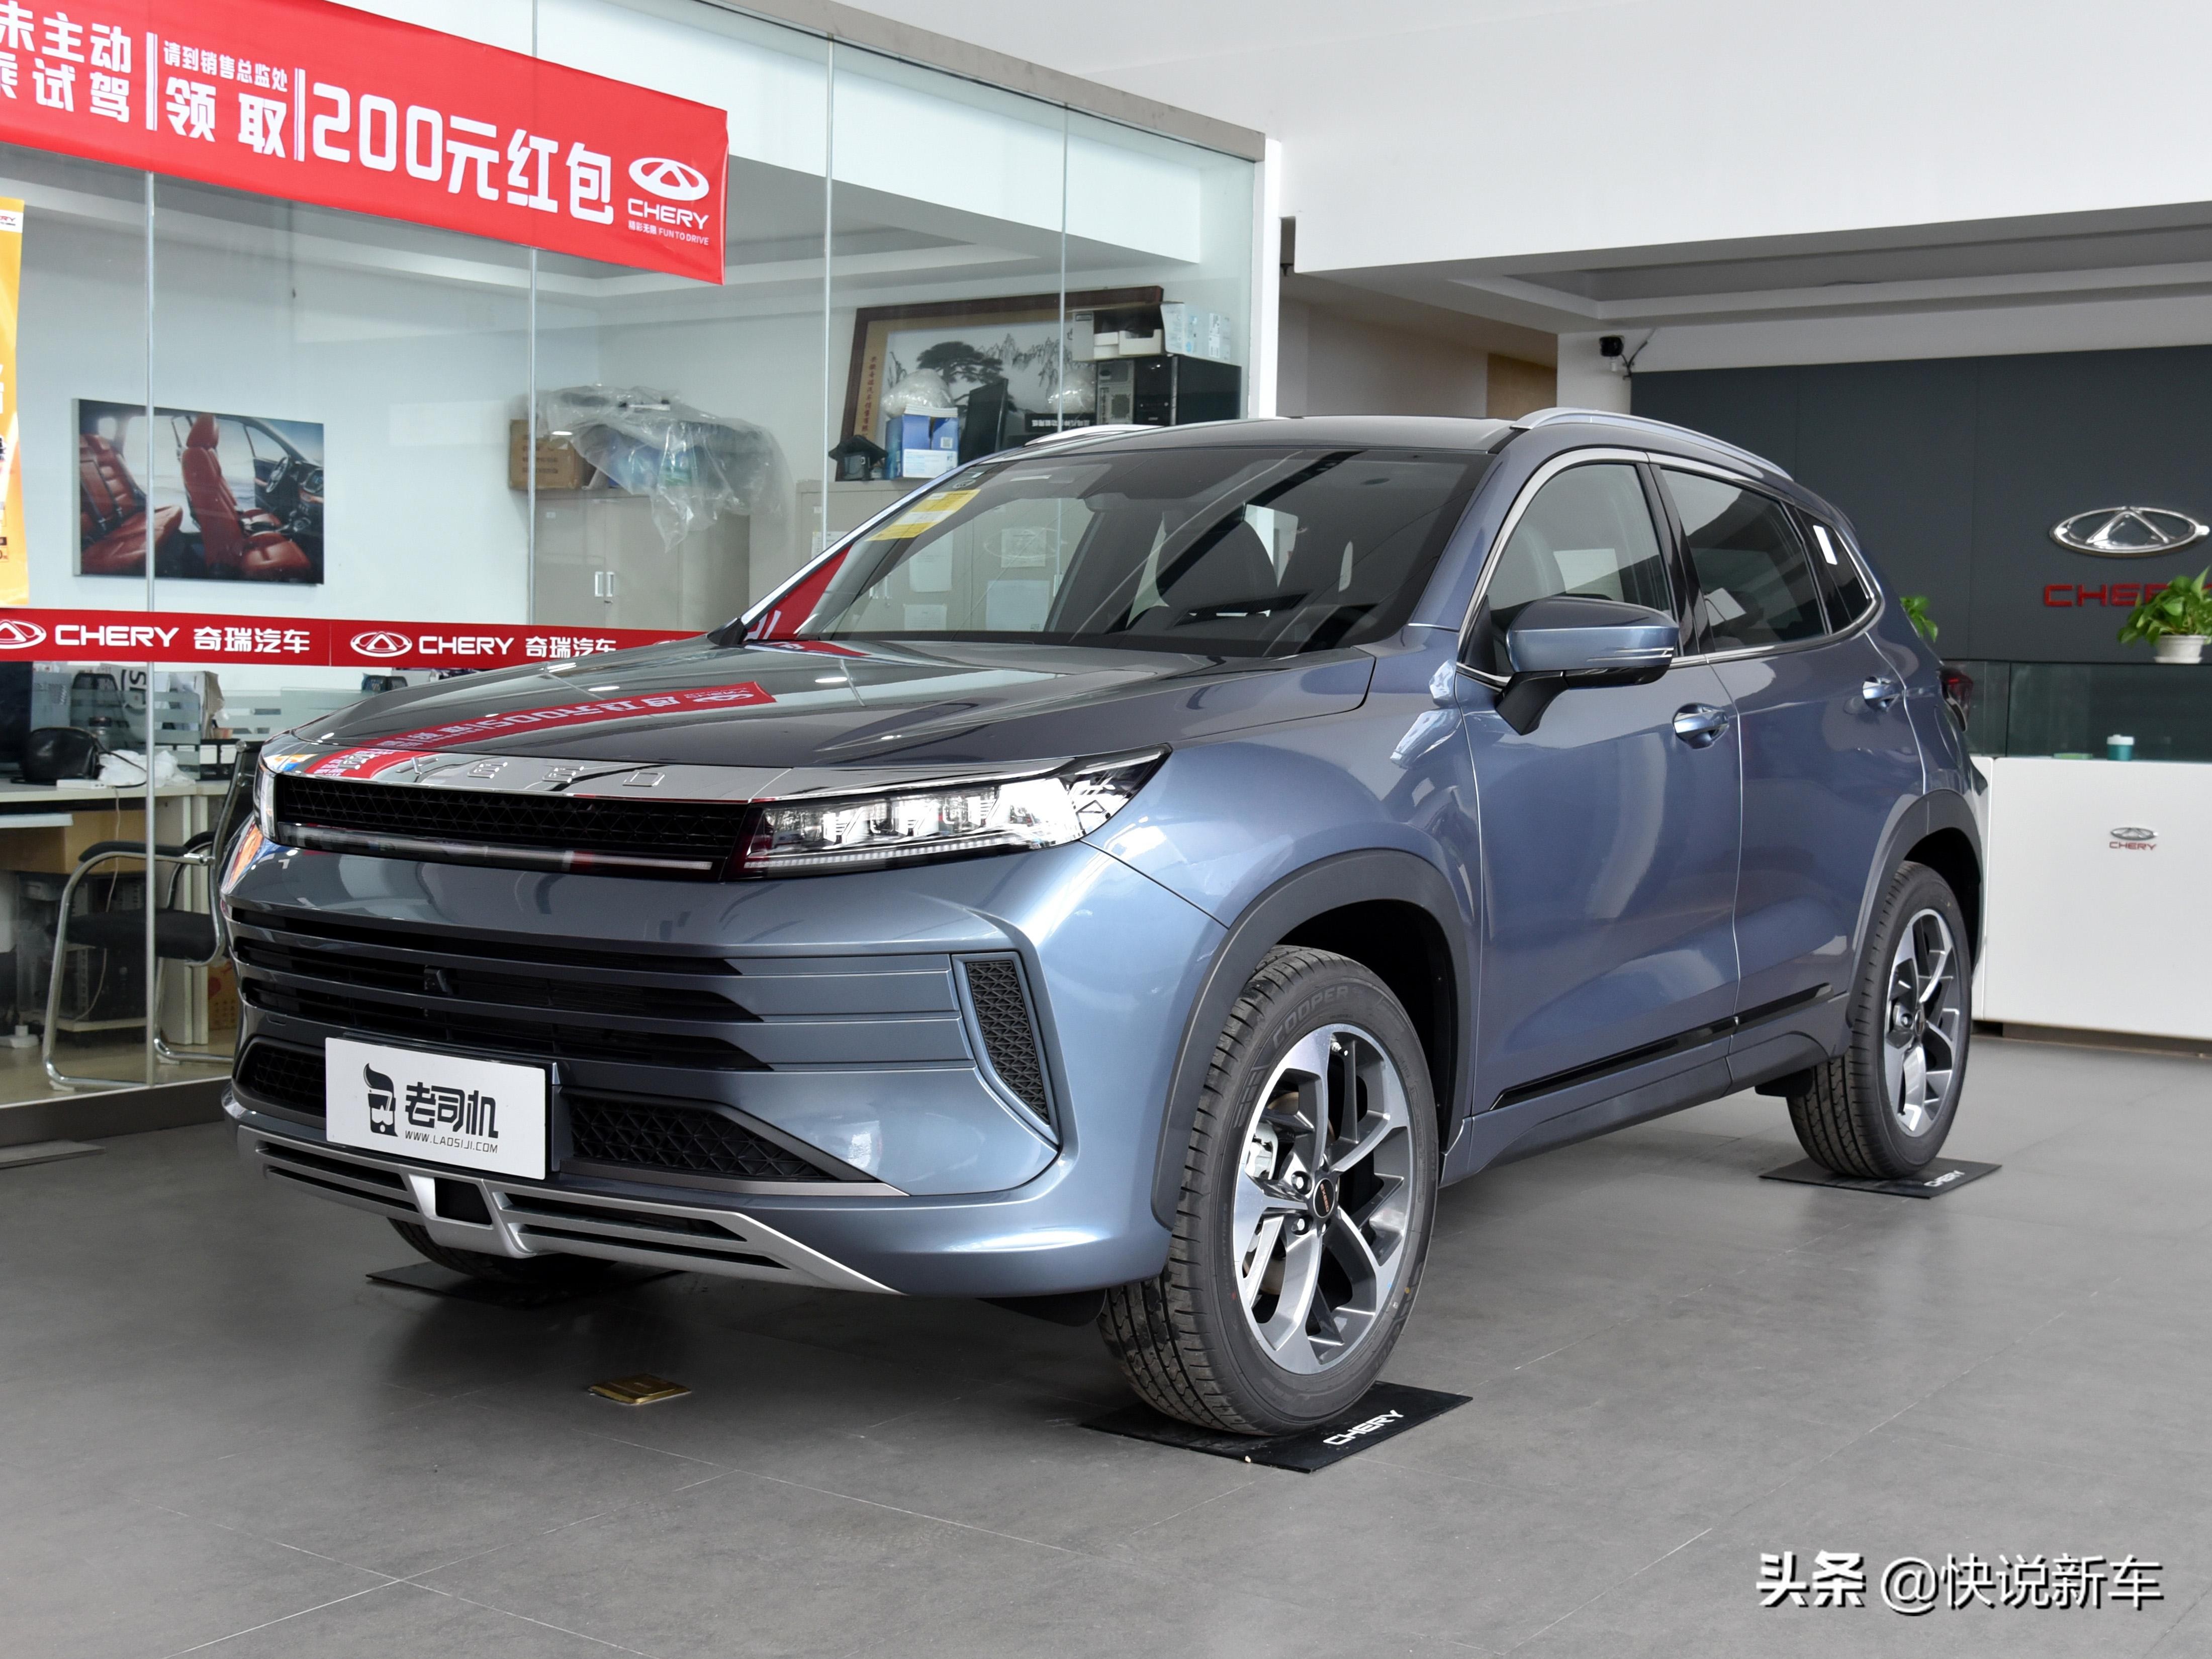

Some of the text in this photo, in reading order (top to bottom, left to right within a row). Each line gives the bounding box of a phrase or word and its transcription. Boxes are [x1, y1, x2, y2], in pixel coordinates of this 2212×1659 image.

[163, 40, 288, 93] 请到销售总监处
[312, 82, 614, 225] 200元红包
[628, 198, 709, 230] CHERY
[628, 220, 709, 245] 精彩无限 FUN TO DRIVE
[2044, 583, 2212, 607] CHE
[55, 624, 310, 654] CHERY 奇瑞汽车
[419, 636, 616, 659] CHERY 奇瑞汽车
[338, 753, 666, 788] EXEED
[2109, 842, 2156, 851] CHERY
[1272, 985, 1349, 1048] COOPER
[405, 1081, 499, 1139] 老司机
[405, 1130, 498, 1153] WWW.LAOSIJI.COM
[1323, 1410, 1404, 1445] CHERY
